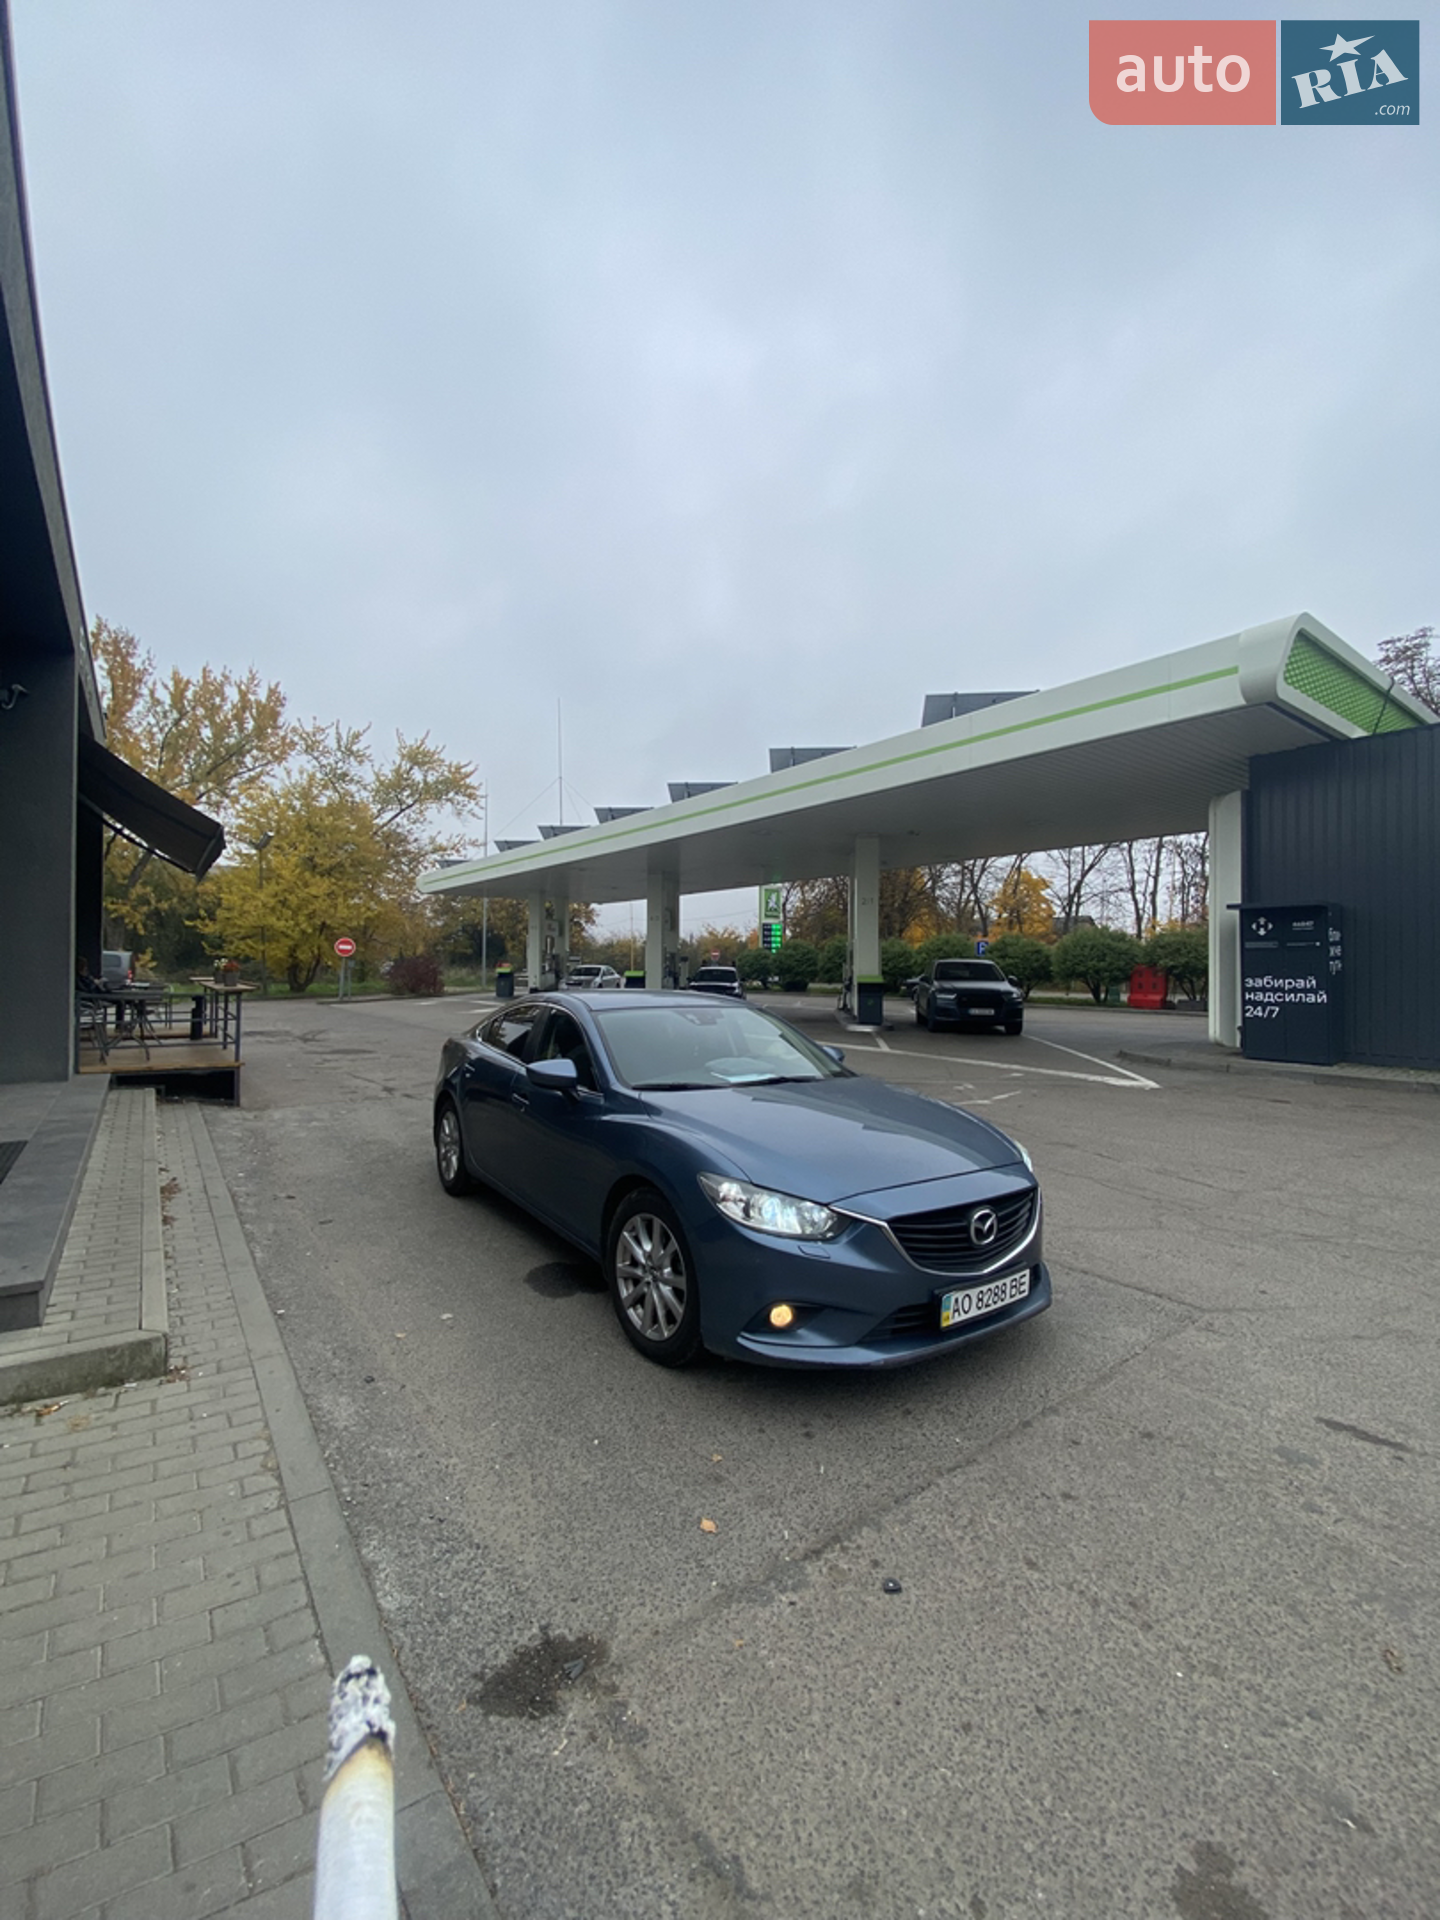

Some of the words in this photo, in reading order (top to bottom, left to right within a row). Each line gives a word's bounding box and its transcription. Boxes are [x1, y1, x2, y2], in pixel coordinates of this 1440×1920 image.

[1244, 976, 1316, 990] забирай
[1245, 990, 1327, 1004] надсилай
[1244, 1005, 1279, 1018] 24/7
[952, 1293, 972, 1319] AO
[976, 1283, 1007, 1310] 8288
[1009, 1274, 1027, 1299] BE
